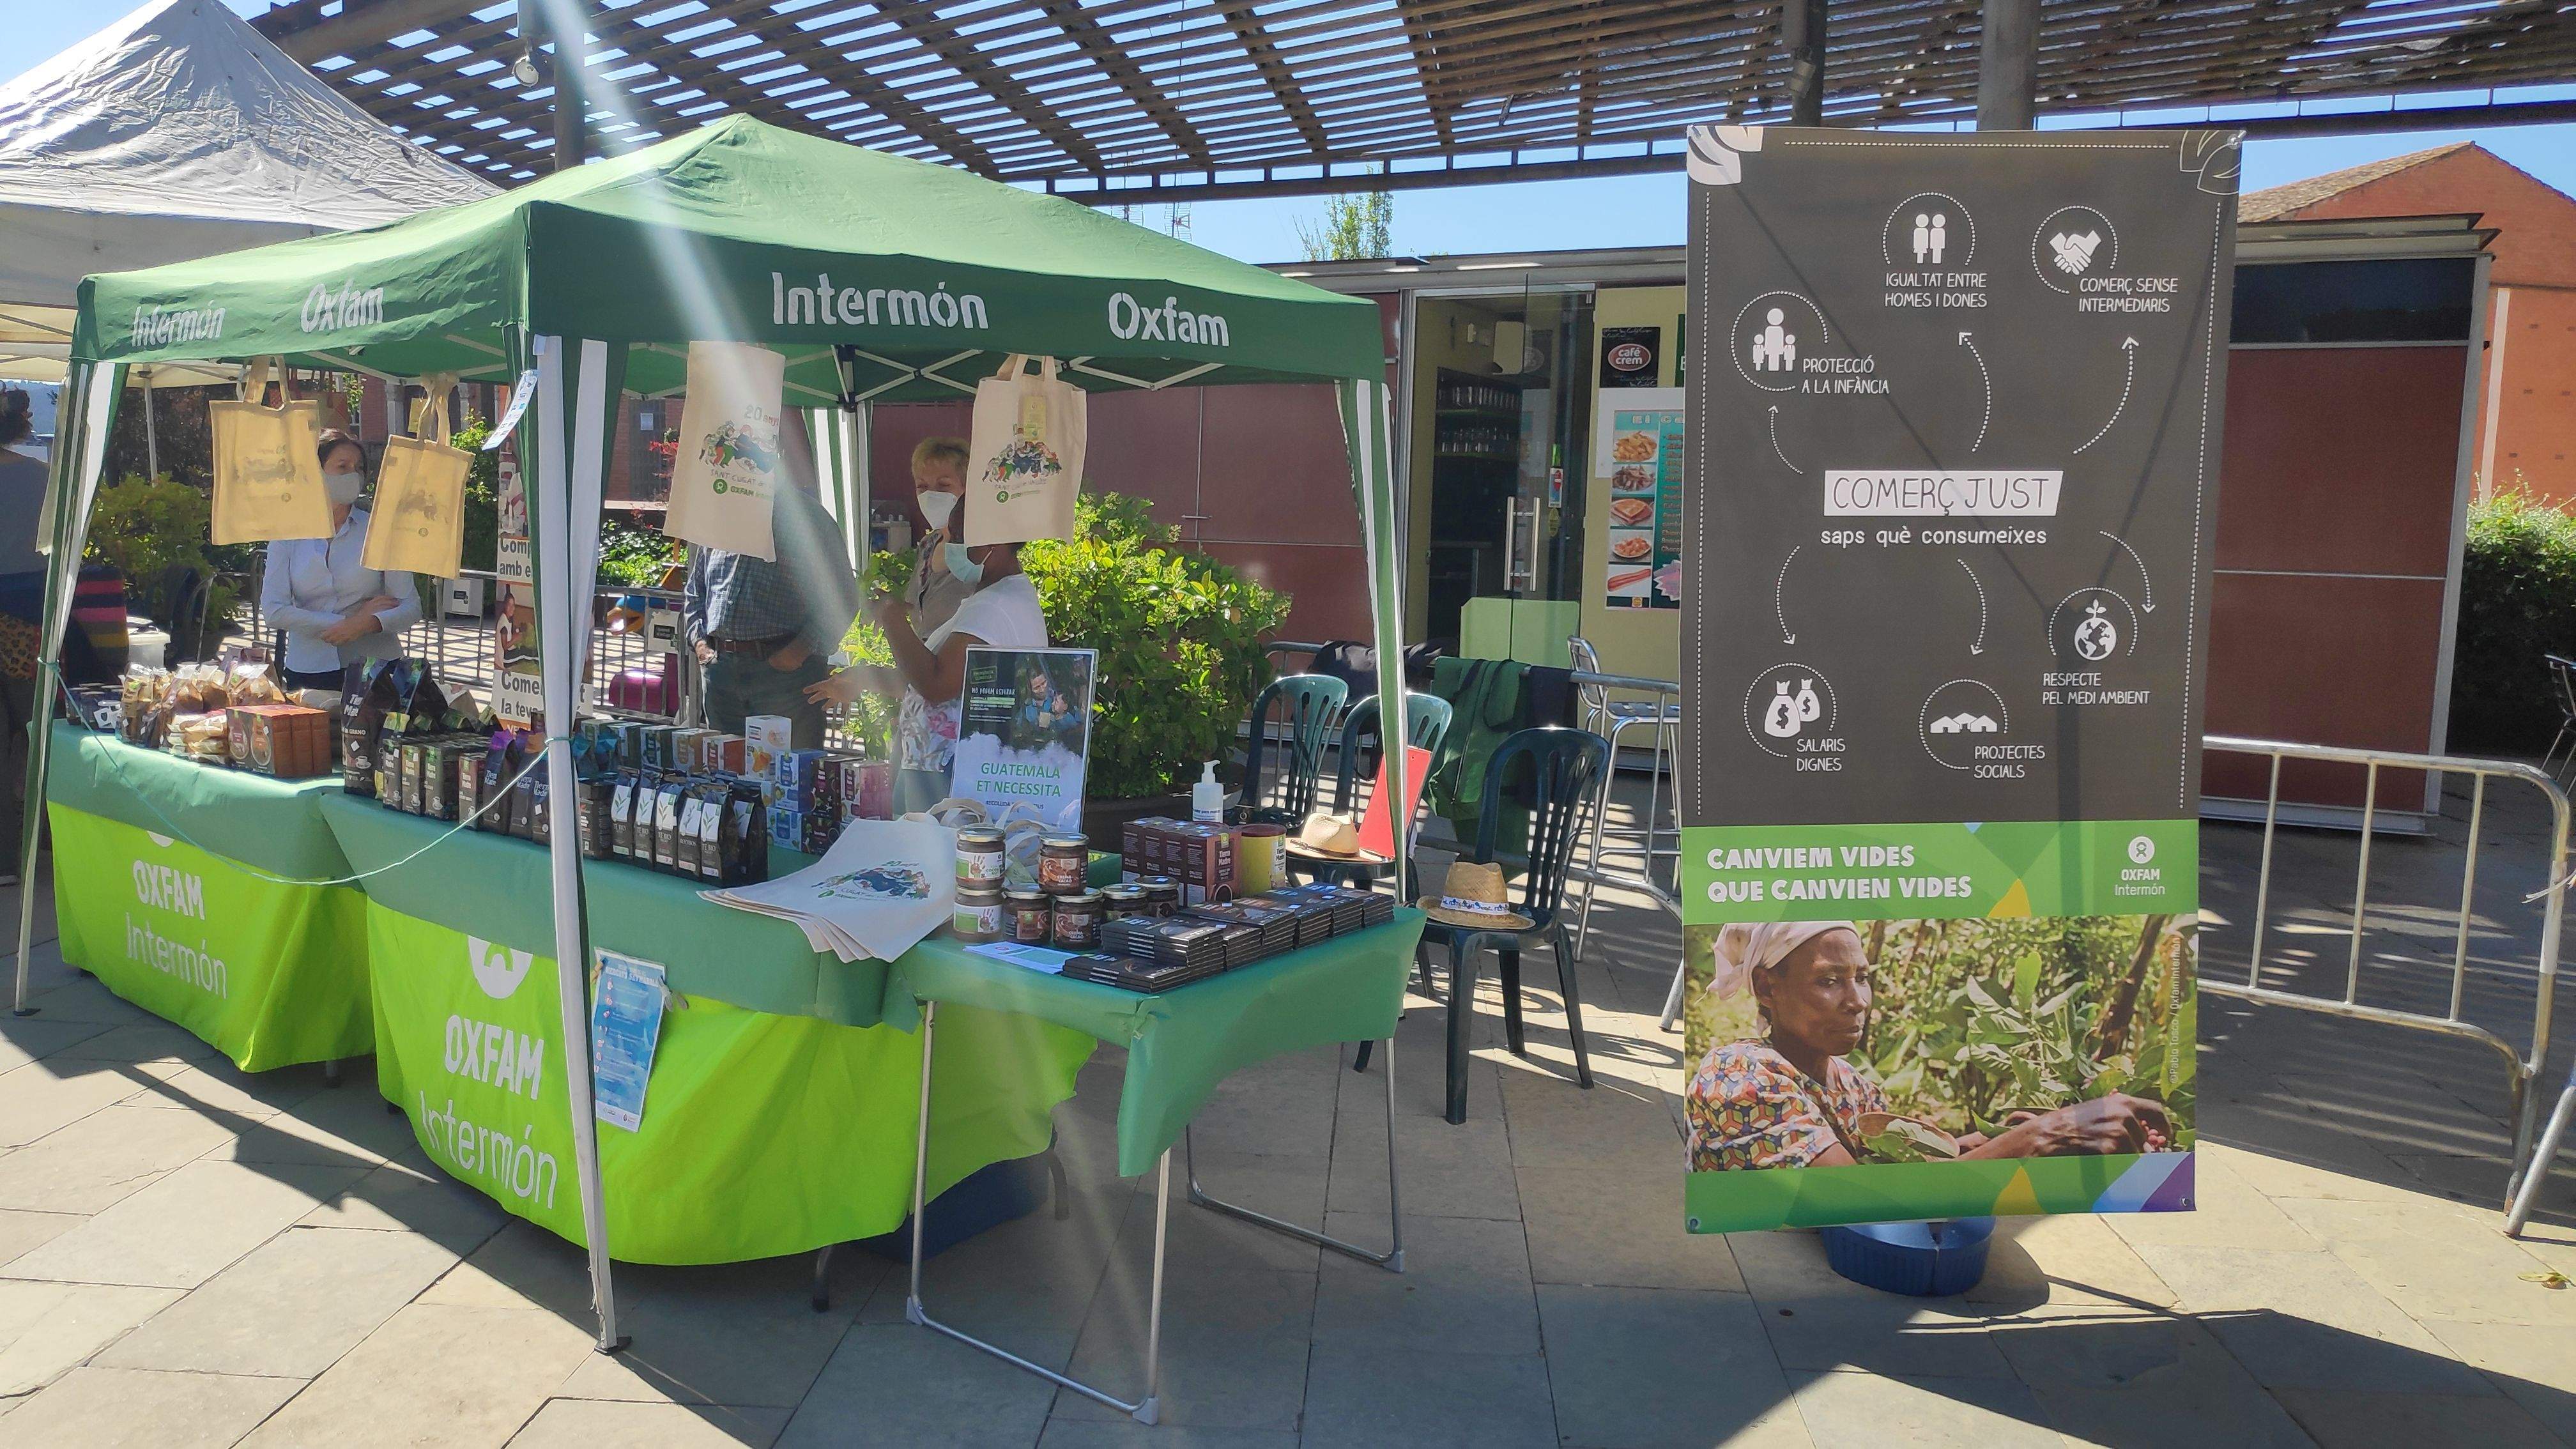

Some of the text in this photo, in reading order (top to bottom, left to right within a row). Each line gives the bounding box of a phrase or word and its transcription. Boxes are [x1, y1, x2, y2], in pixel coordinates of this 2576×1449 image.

[1885, 272, 1987, 288] IGUALTAT ENTRE
[2080, 277, 2178, 295] COMERÇ SENSE
[1885, 293, 1987, 308] HOMES I DONES
[2078, 297, 2170, 313] INTERMEDIARIS
[132, 279, 383, 347] Intermón Oxfam
[772, 272, 1230, 347] Intermón Oxfam
[1618, 347, 1641, 357] café
[1802, 355, 1874, 374] PROTECCIÓ
[1802, 376, 1890, 395] A LA INFÀNCIA
[744, 404, 763, 421] 20
[1832, 477, 2049, 516] COMERÇ JUST
[1820, 525, 2046, 548] saps què consumeixes
[499, 561, 522, 578] amb
[2043, 672, 2101, 687] RESPECTE
[2043, 690, 2150, 705] PEL MEDI AMBIENT
[501, 698, 512, 715] la
[1796, 738, 1846, 754] SALARIS
[1974, 744, 2045, 762] PROJECTES
[981, 762, 1061, 779] GUATEMALA
[1796, 757, 1842, 772] DIGNES
[1974, 763, 2025, 779] SOCIALS
[977, 780, 1061, 797] ET NECESSITA
[1707, 845, 1915, 871] CANVIEM VIDES
[2121, 869, 2161, 881] OXFAM
[133, 861, 206, 921] OXFAM
[1707, 876, 1972, 903] QUE CANVIEN VIDES
[2115, 882, 2165, 896] Intermón
[126, 911, 227, 999] Intermón
[2170, 982, 2181, 1009] Oxfam
[444, 1014, 544, 1101] OXFAM
[419, 1089, 558, 1209] Intermón
